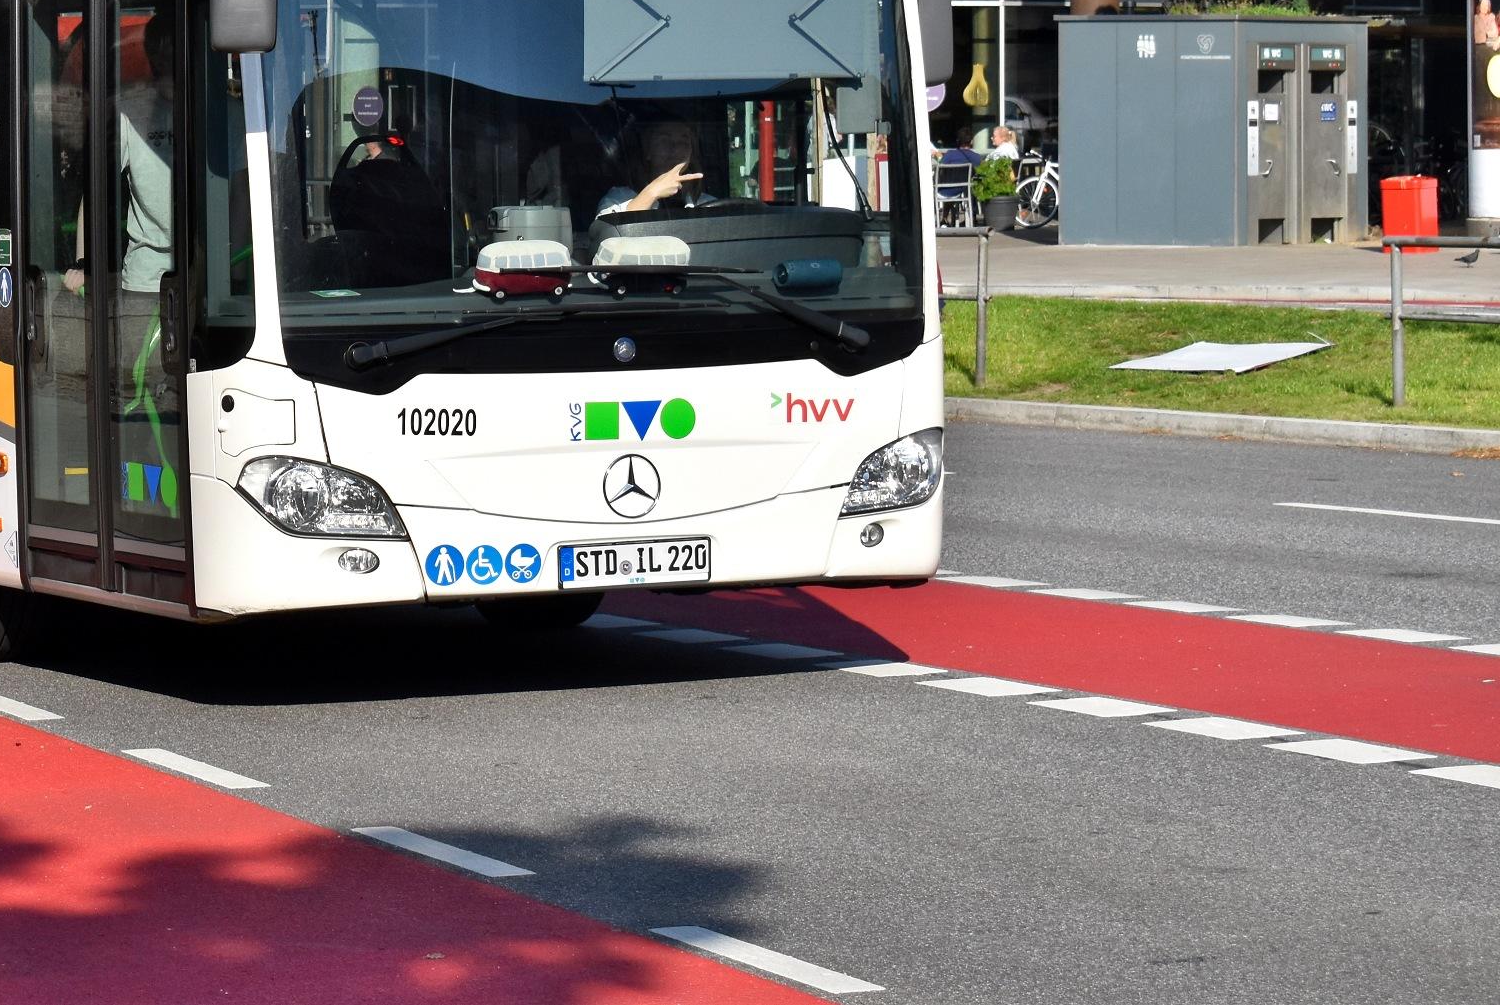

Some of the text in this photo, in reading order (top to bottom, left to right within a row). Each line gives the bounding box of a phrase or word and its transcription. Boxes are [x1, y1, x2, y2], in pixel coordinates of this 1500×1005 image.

[397, 407, 477, 437] 102020
[569, 402, 583, 442] KVG
[786, 392, 855, 423] hvv
[564, 567, 571, 576] D
[575, 543, 707, 577] STD IL 220
